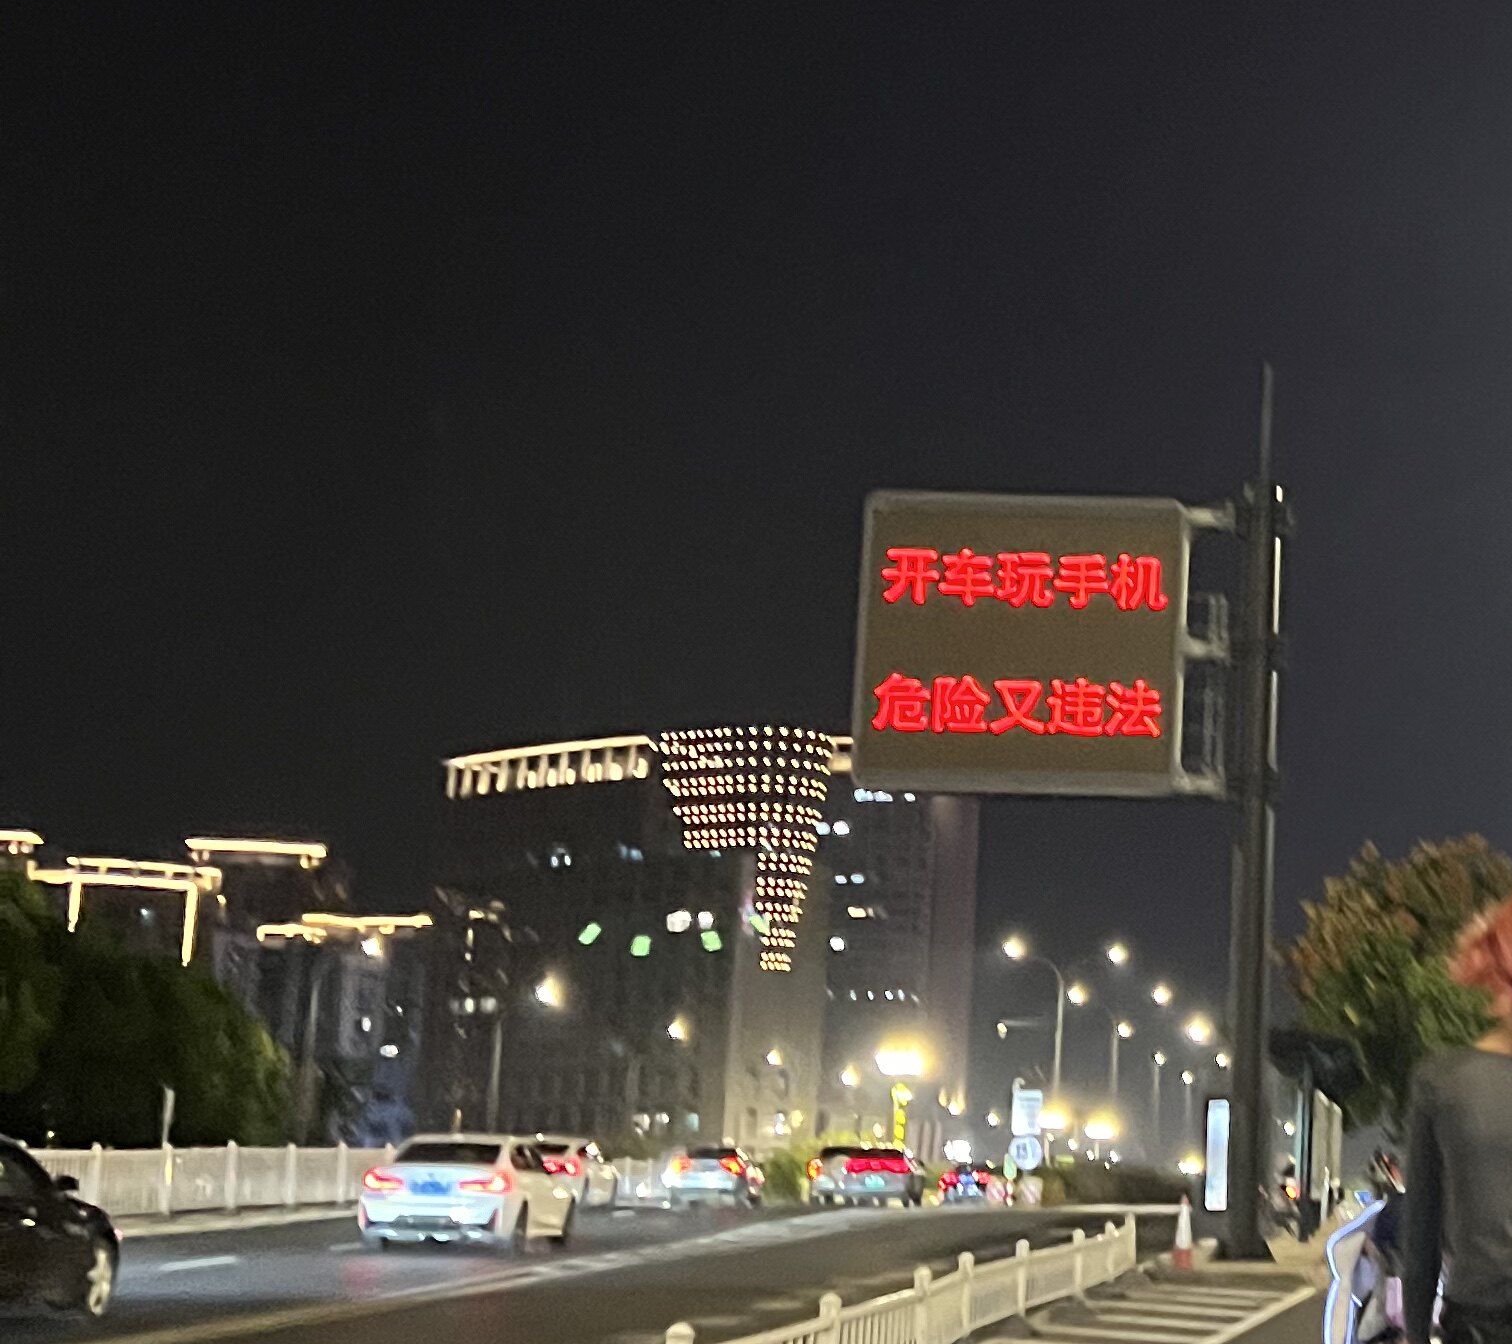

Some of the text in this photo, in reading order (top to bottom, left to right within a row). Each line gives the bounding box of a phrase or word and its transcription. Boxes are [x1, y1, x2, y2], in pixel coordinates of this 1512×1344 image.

[881, 547, 1169, 611] 开车玩手机
[871, 672, 1162, 738] 危险又违法
